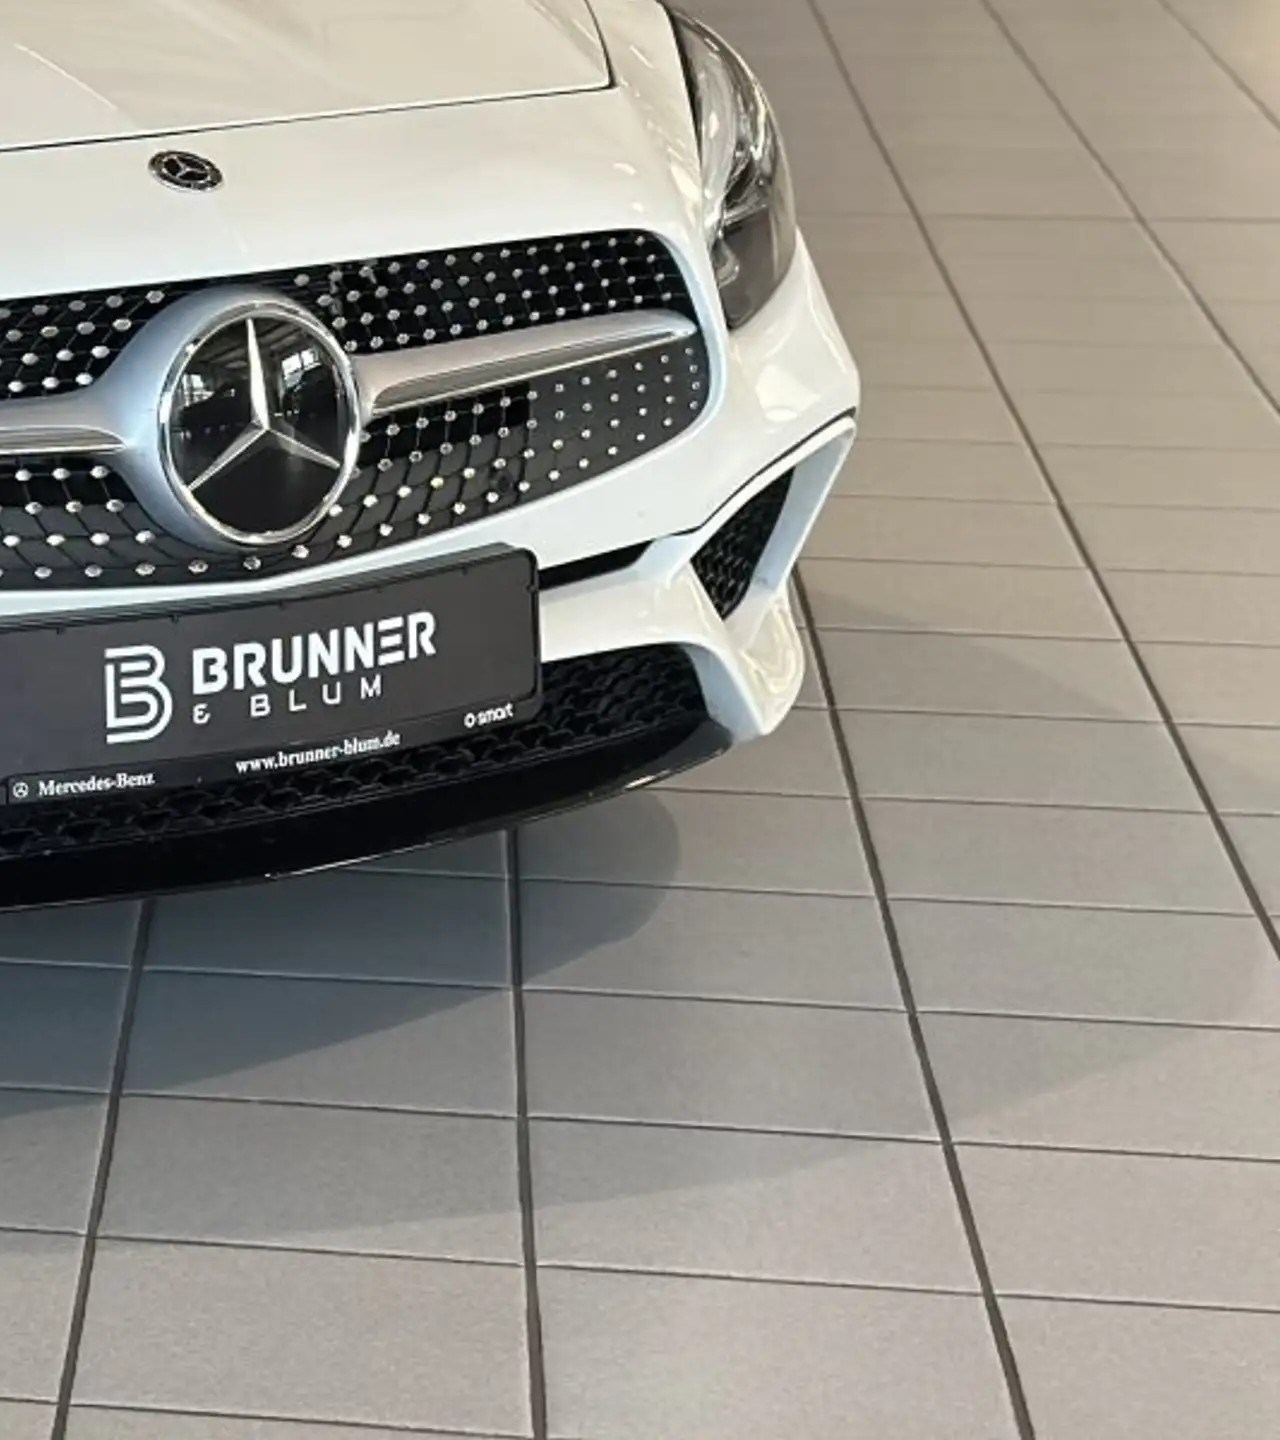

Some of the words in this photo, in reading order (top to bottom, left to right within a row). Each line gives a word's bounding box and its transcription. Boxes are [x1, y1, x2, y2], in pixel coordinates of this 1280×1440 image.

[192, 610, 437, 695] BRUNNER
[193, 703, 212, 724] &
[250, 673, 383, 717] BLUM
[236, 729, 401, 774] www.brunner-blum.de
[38, 772, 155, 797] Mercedes-Benz
